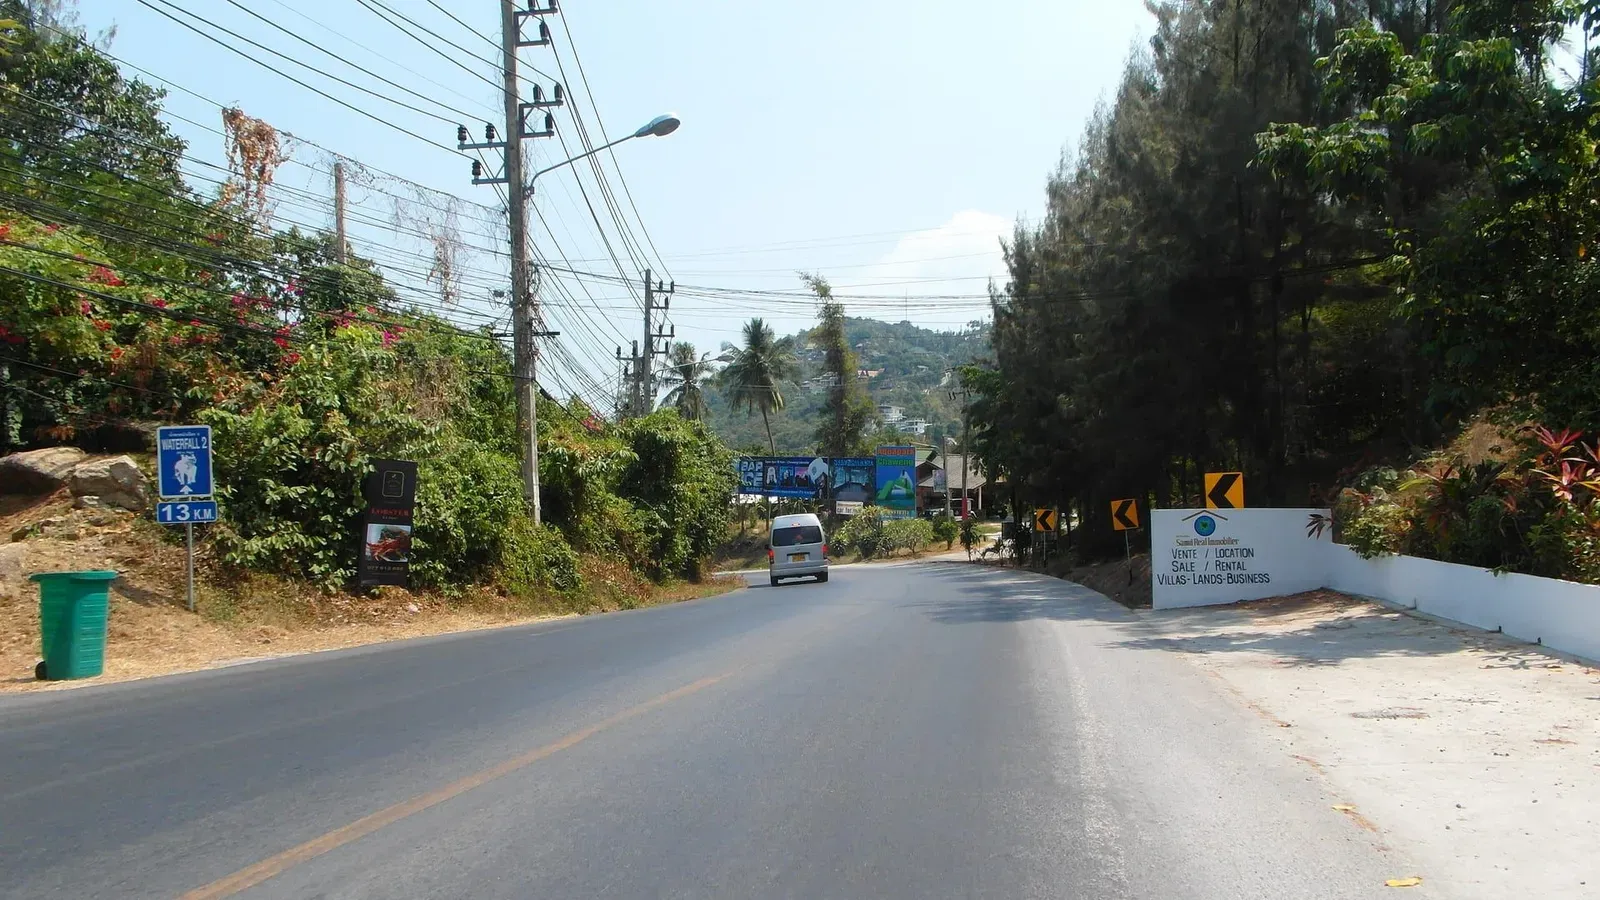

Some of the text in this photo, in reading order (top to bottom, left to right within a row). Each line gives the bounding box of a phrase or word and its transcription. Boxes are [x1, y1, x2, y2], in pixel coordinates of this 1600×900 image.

[162, 436, 208, 450] WATERFALL 2
[741, 461, 763, 471] BAR
[878, 458, 913, 466] Chaweng
[162, 504, 214, 521] 13 K.M.
[371, 507, 409, 516] LOBSTER
[1193, 538, 1207, 546] Real
[1208, 537, 1240, 546] Immobilier
[1172, 548, 1254, 559] VENTE / LOCATION
[1172, 560, 1247, 572] SALE / RENTAL
